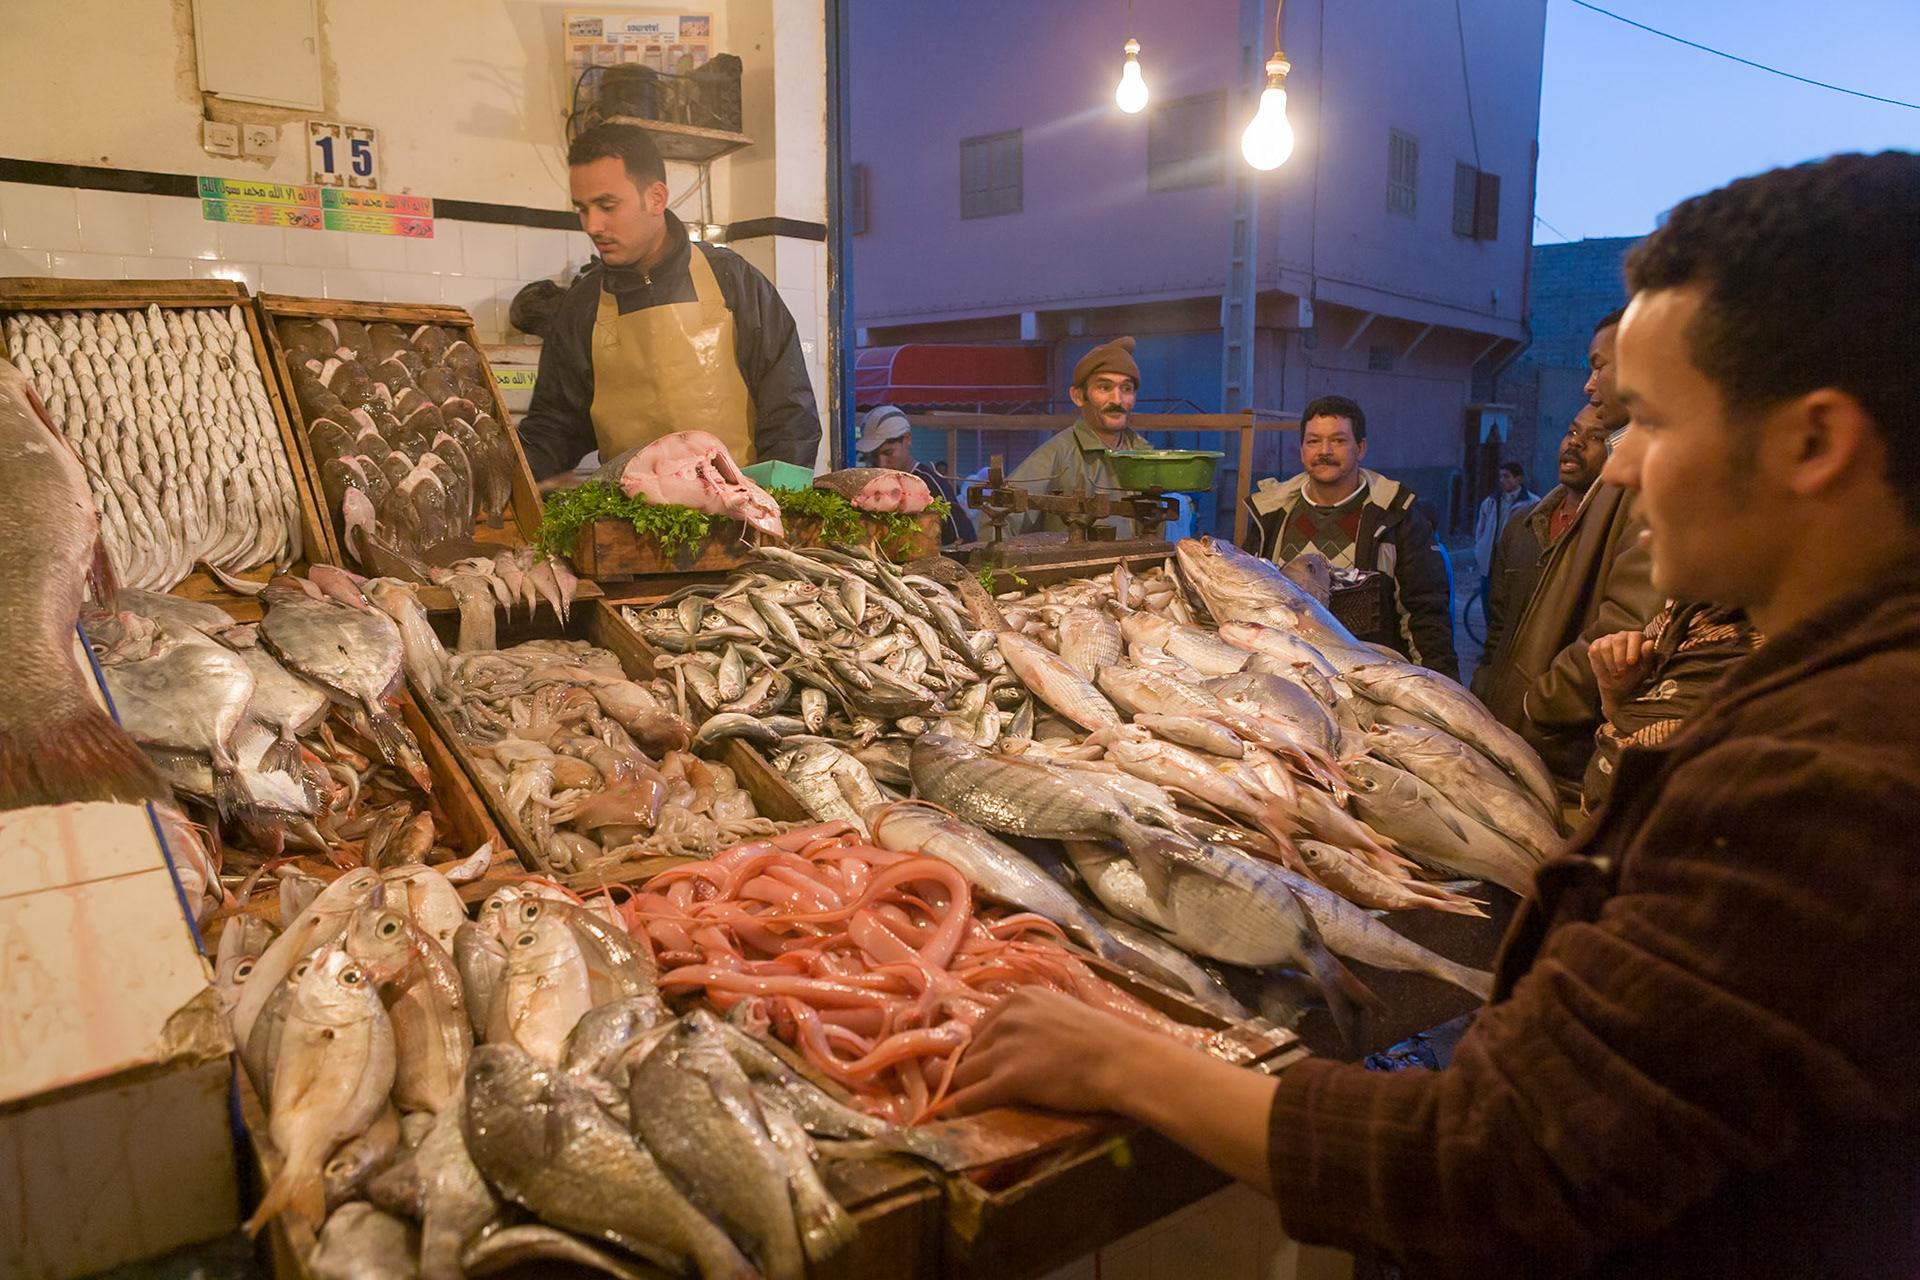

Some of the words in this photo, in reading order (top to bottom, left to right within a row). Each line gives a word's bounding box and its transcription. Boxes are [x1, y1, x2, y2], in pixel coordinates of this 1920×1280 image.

[202, 179, 218, 193] الله
[243, 186, 266, 198] محمد
[268, 185, 284, 199] الله
[512, 371, 526, 385] الله
